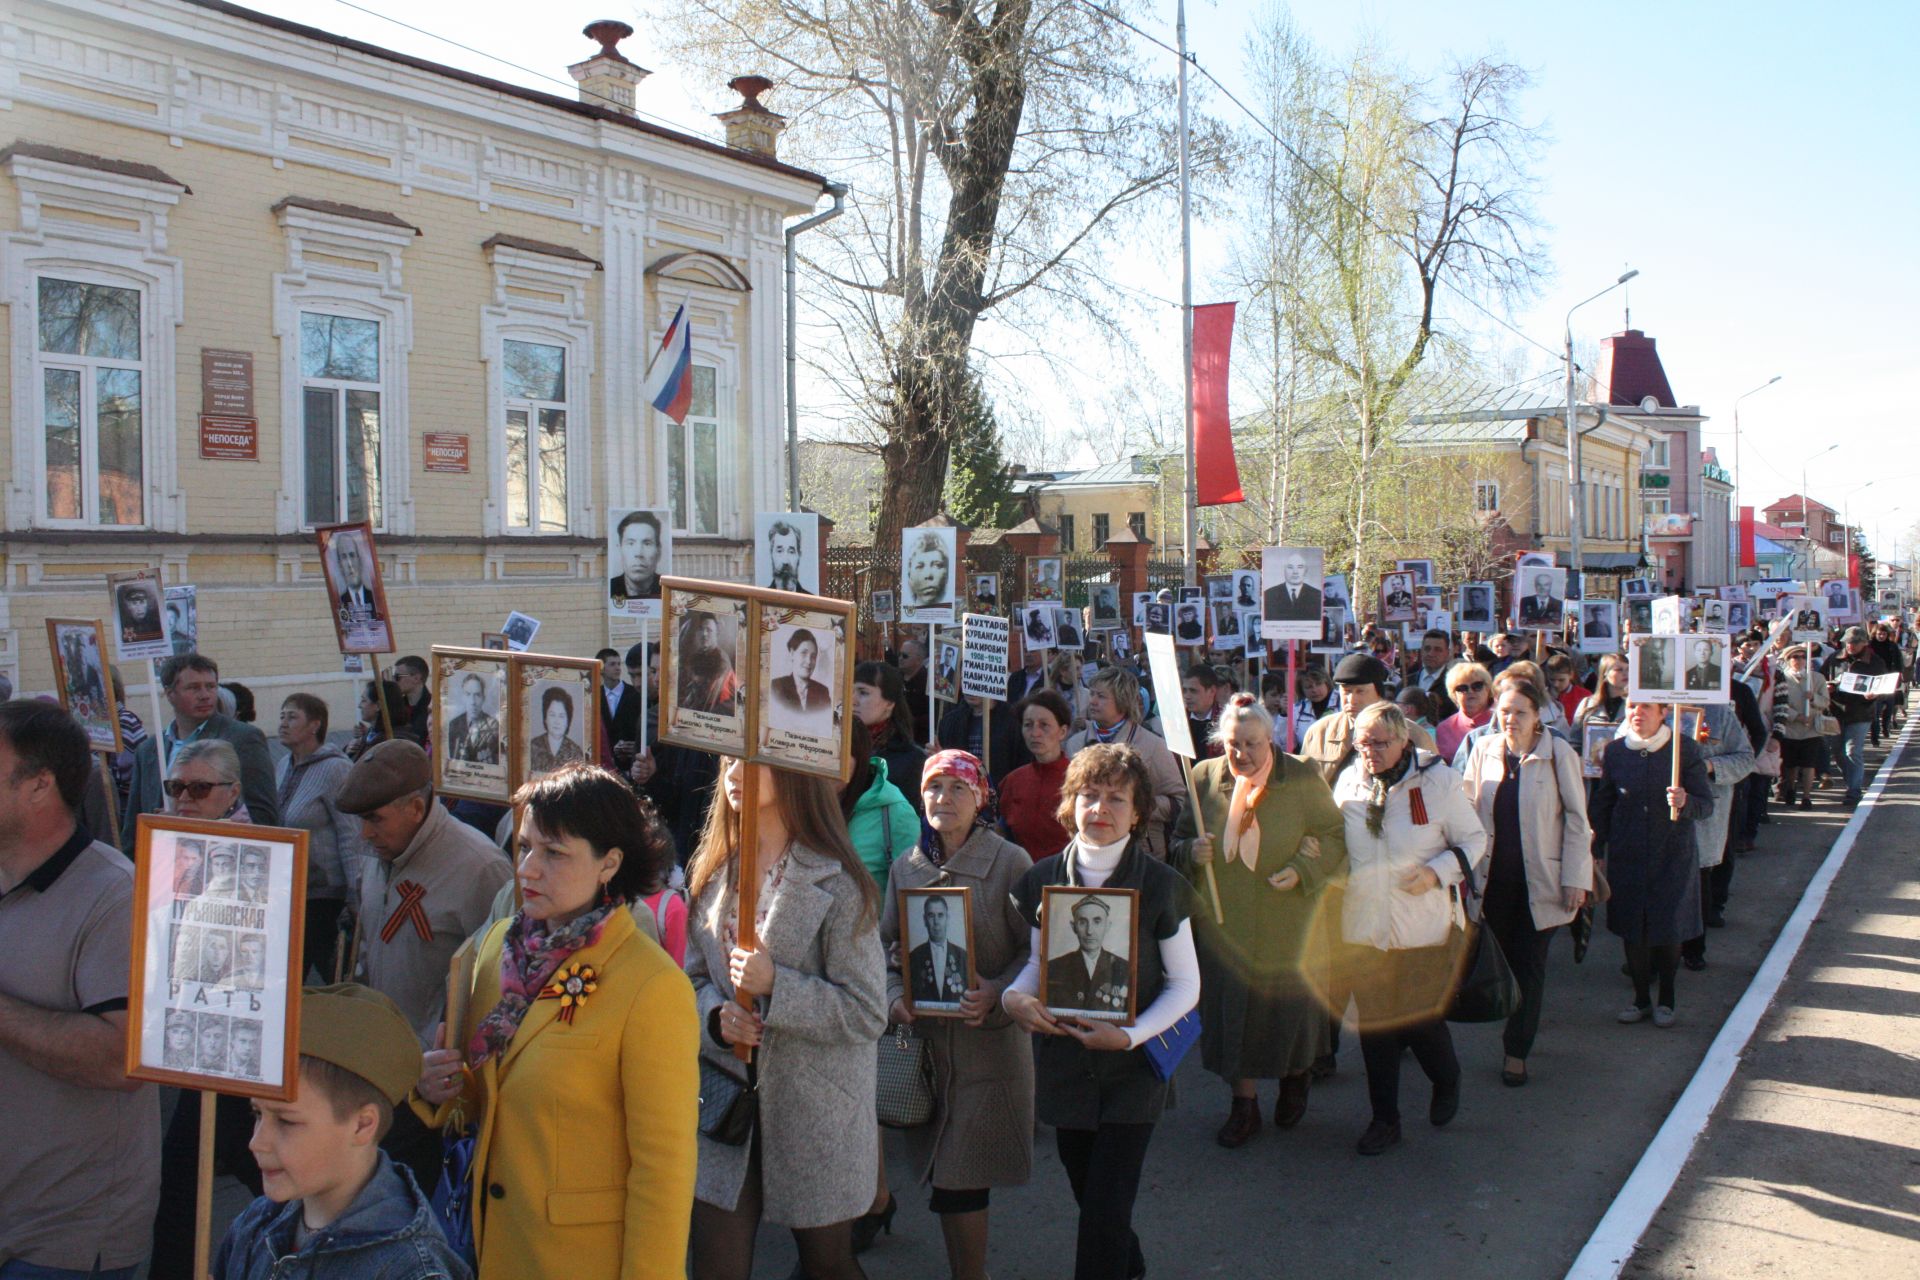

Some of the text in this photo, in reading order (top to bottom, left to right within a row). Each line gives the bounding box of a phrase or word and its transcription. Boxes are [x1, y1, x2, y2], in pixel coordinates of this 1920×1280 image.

[965, 617, 1009, 632] МУХТАРОВ
[965, 629, 1008, 643] КУРБАНГАЛИ
[964, 641, 1007, 655] ЗАКИРОВИЧ
[964, 660, 1007, 674] ТИМЕРБАЕВ
[963, 681, 1006, 697] ТИМЕРБАЕВИЧ
[172, 899, 265, 930] ГУРЬЯНОВСКАЯ
[168, 982, 262, 1012] РАТЬ
